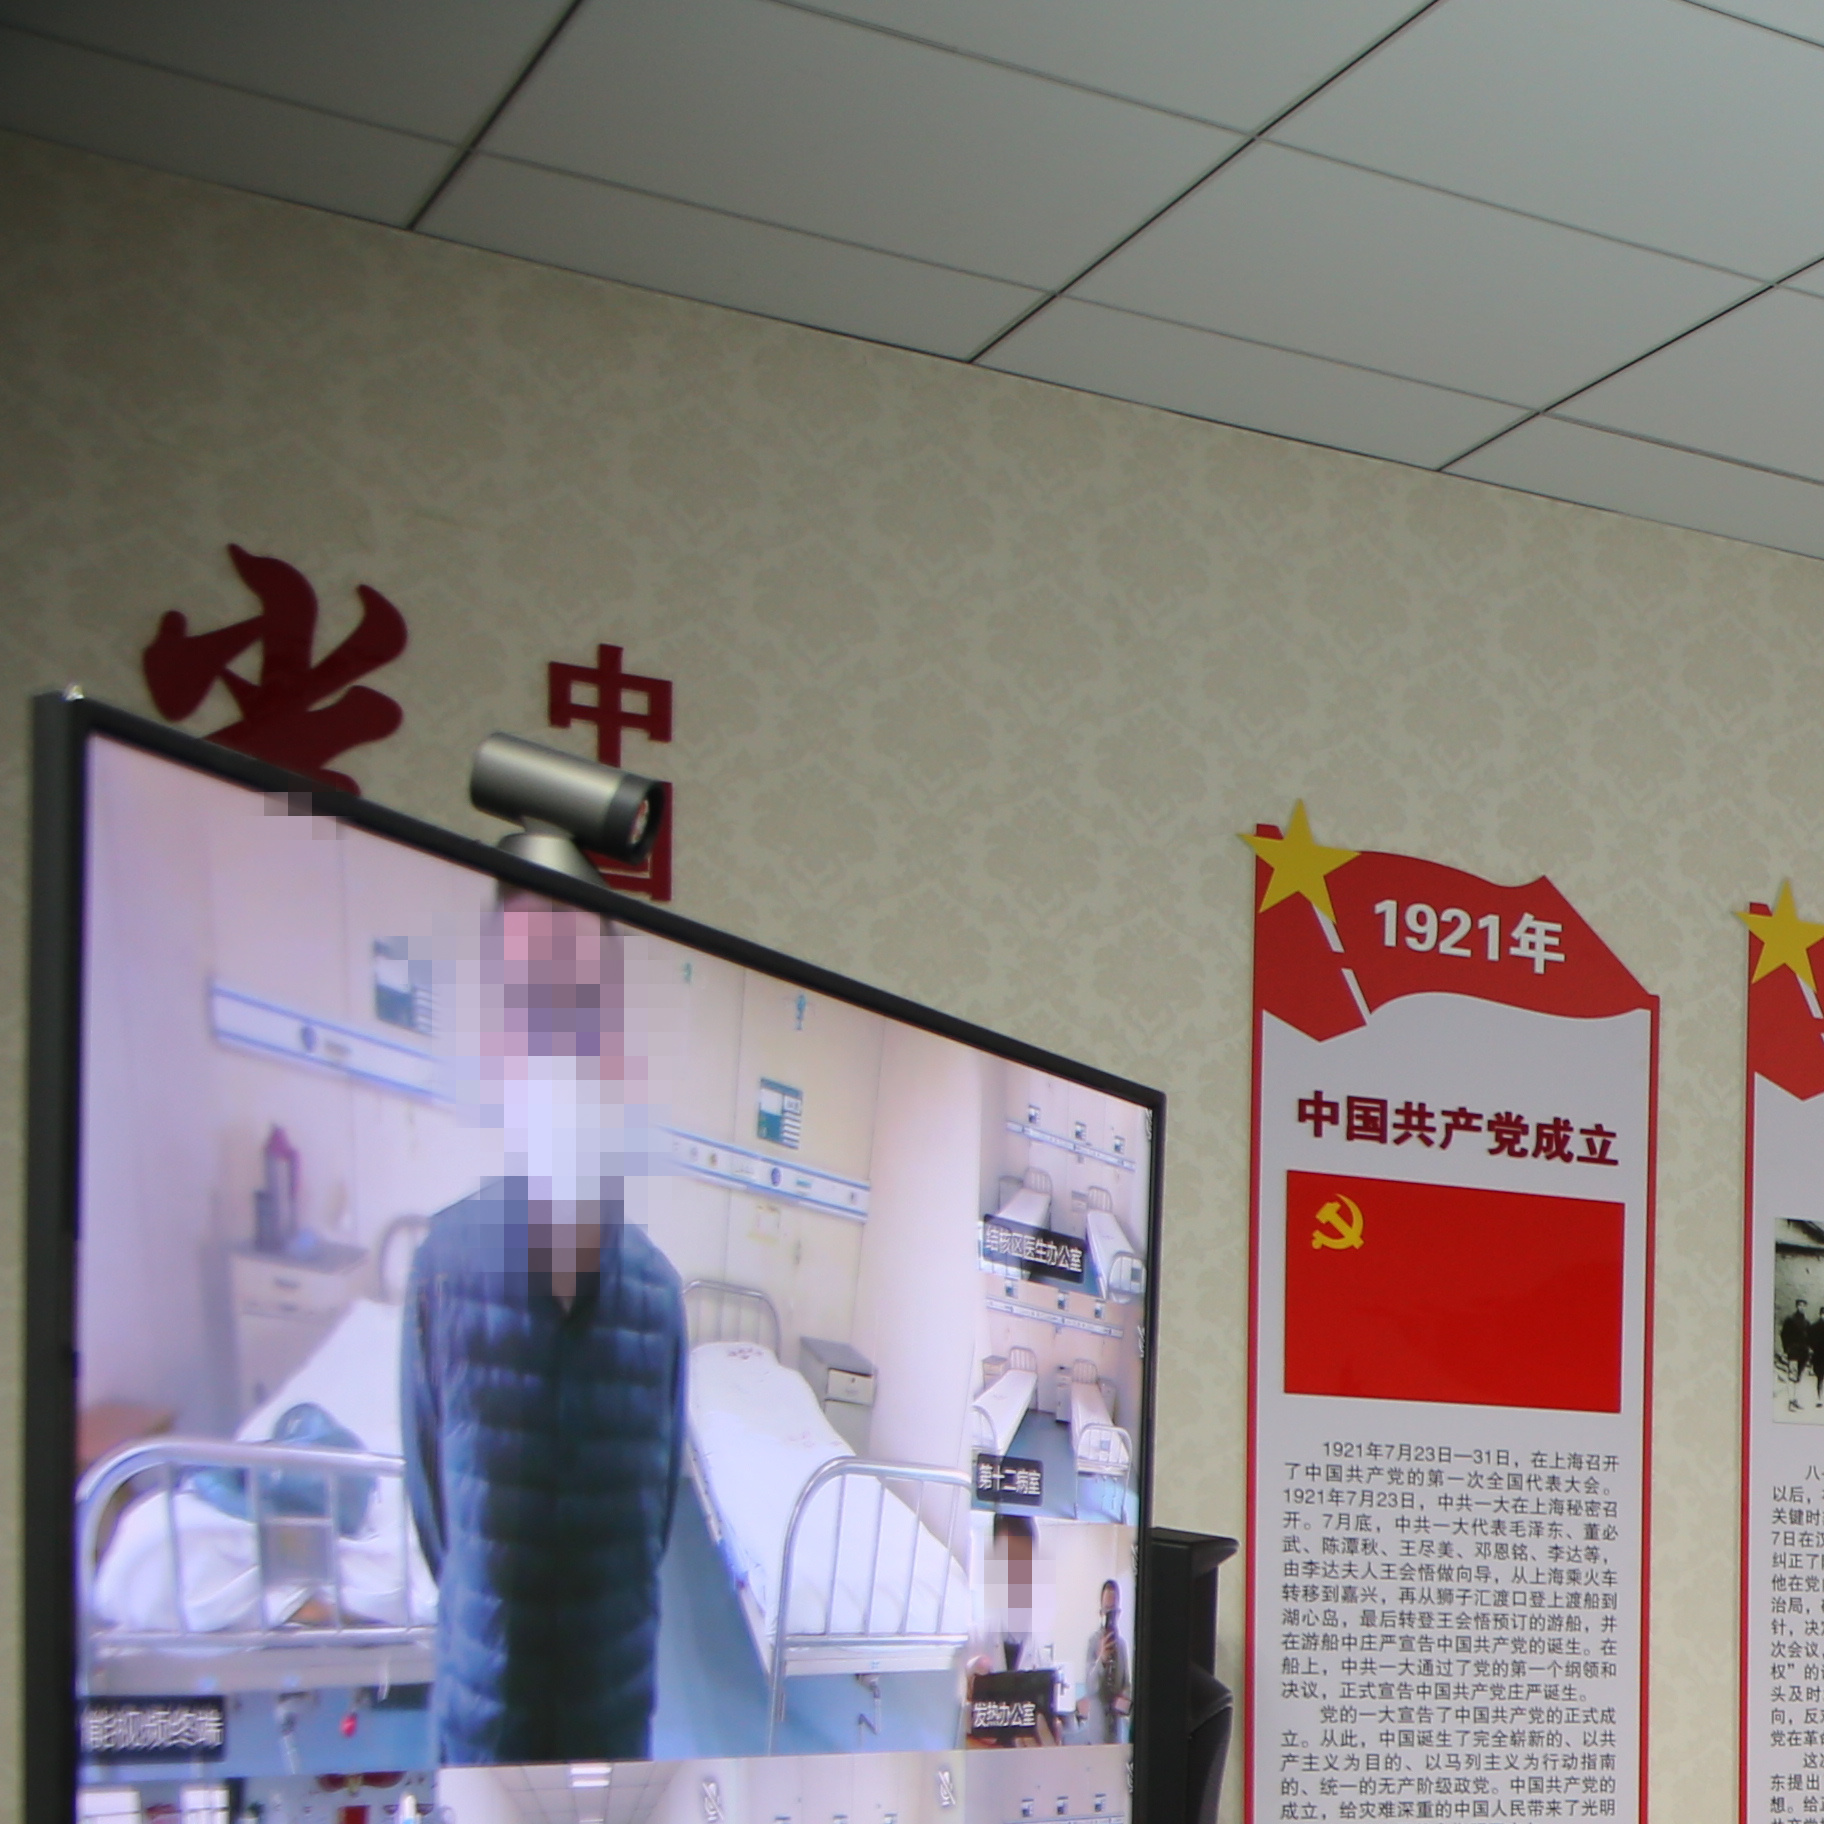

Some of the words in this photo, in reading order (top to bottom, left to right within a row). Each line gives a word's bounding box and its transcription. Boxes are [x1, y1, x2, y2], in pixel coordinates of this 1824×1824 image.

[1375, 899, 1565, 973] 1921年
[1296, 1090, 1620, 1167] 中国共产党成立
[978, 1463, 1041, 1496] 第十二病室
[974, 1701, 1036, 1727] 发热办公室
